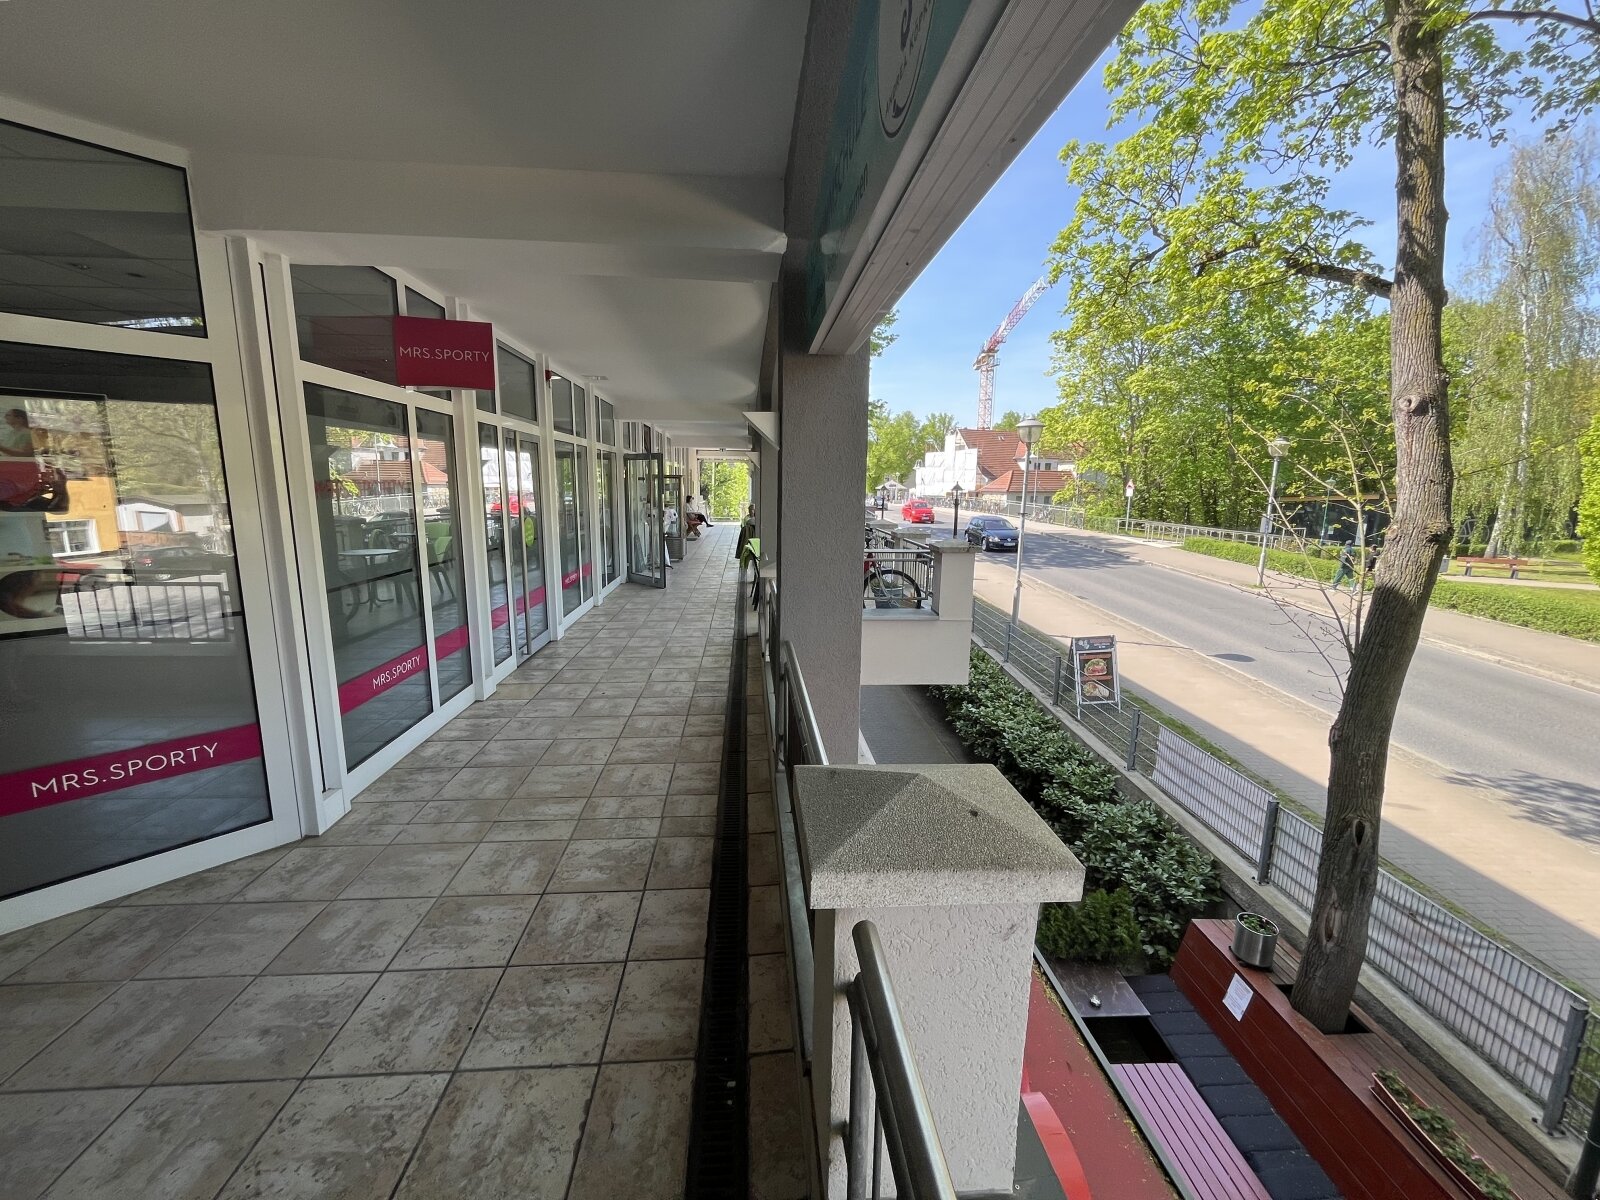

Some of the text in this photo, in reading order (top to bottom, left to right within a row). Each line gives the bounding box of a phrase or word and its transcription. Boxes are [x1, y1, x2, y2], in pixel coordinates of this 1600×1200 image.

[399, 346, 490, 362] MRS.SPORTY
[372, 654, 421, 690] MRS.SPORTY
[31, 742, 218, 798] MRS.SPORTY
